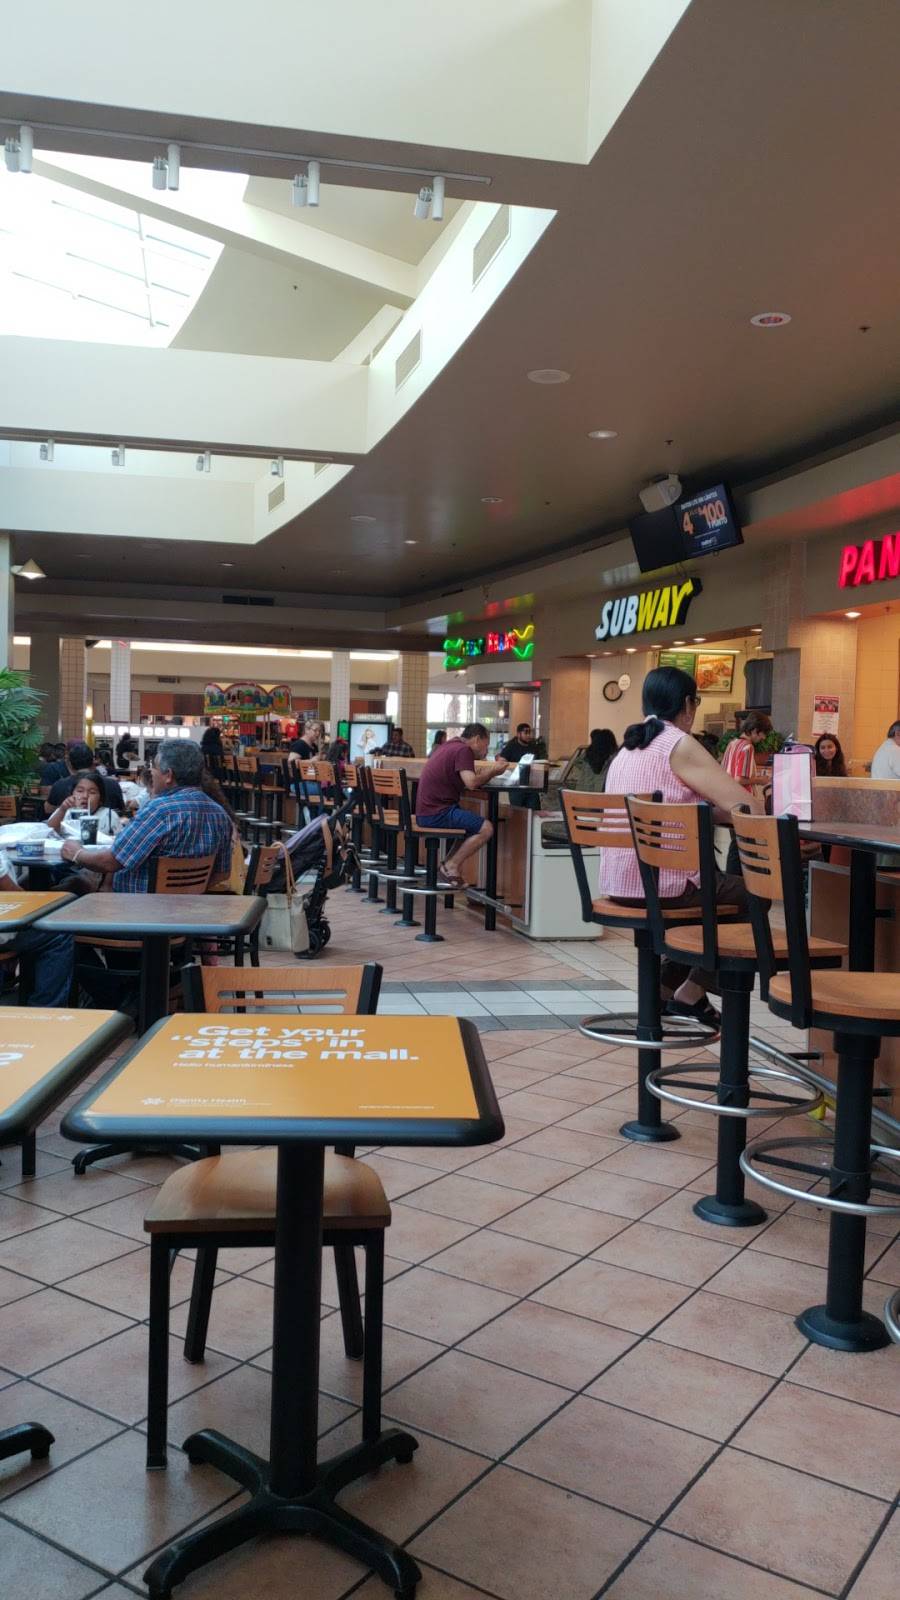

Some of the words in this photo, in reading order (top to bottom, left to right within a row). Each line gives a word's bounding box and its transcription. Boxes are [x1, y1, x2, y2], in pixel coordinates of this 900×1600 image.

[683, 512, 694, 535] 4
[595, 578, 694, 640] SUBWAY
[198, 1025, 271, 1037] Get
[278, 1027, 366, 1039] your
[329, 1036, 365, 1048] in
[178, 1048, 224, 1060] at
[239, 1048, 308, 1060] the
[319, 1048, 420, 1061] mall.
